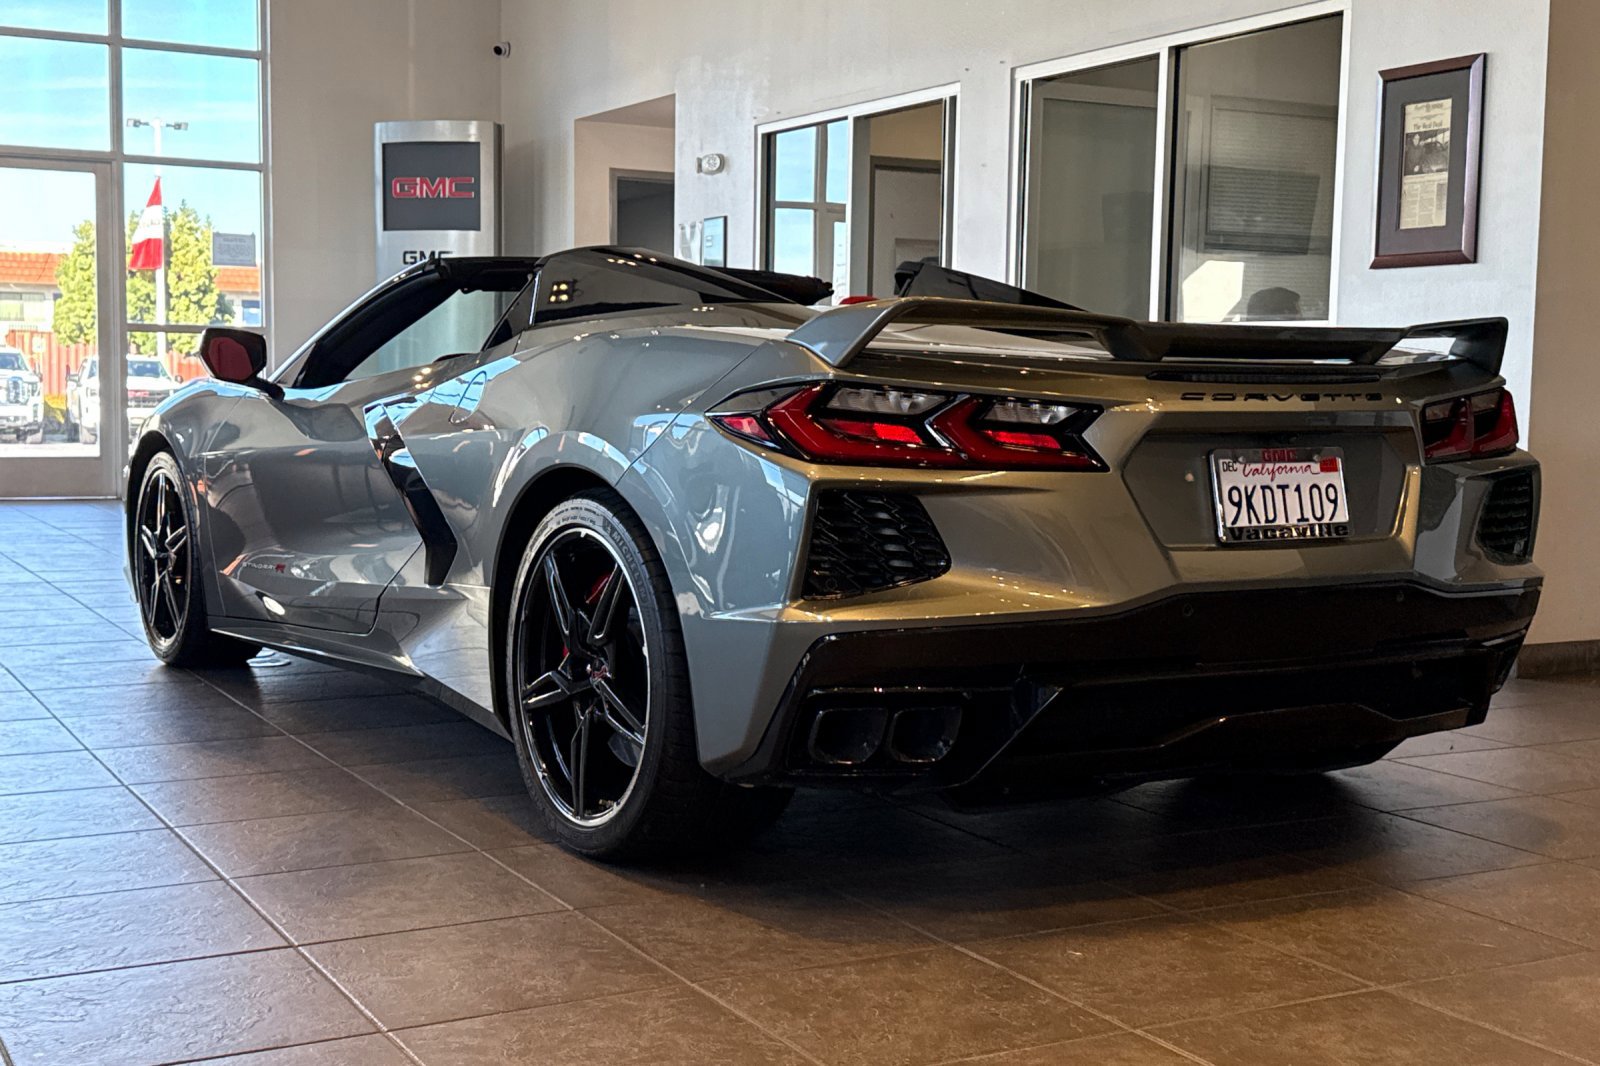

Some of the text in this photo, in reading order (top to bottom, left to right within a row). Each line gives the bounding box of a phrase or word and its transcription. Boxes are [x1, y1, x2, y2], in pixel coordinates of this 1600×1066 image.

[391, 176, 475, 199] GMC
[1180, 392, 1383, 402] CORVETTE
[1242, 461, 1321, 482] California
[1227, 483, 1338, 526] 9KDT109
[1228, 523, 1349, 541] Vacaville
